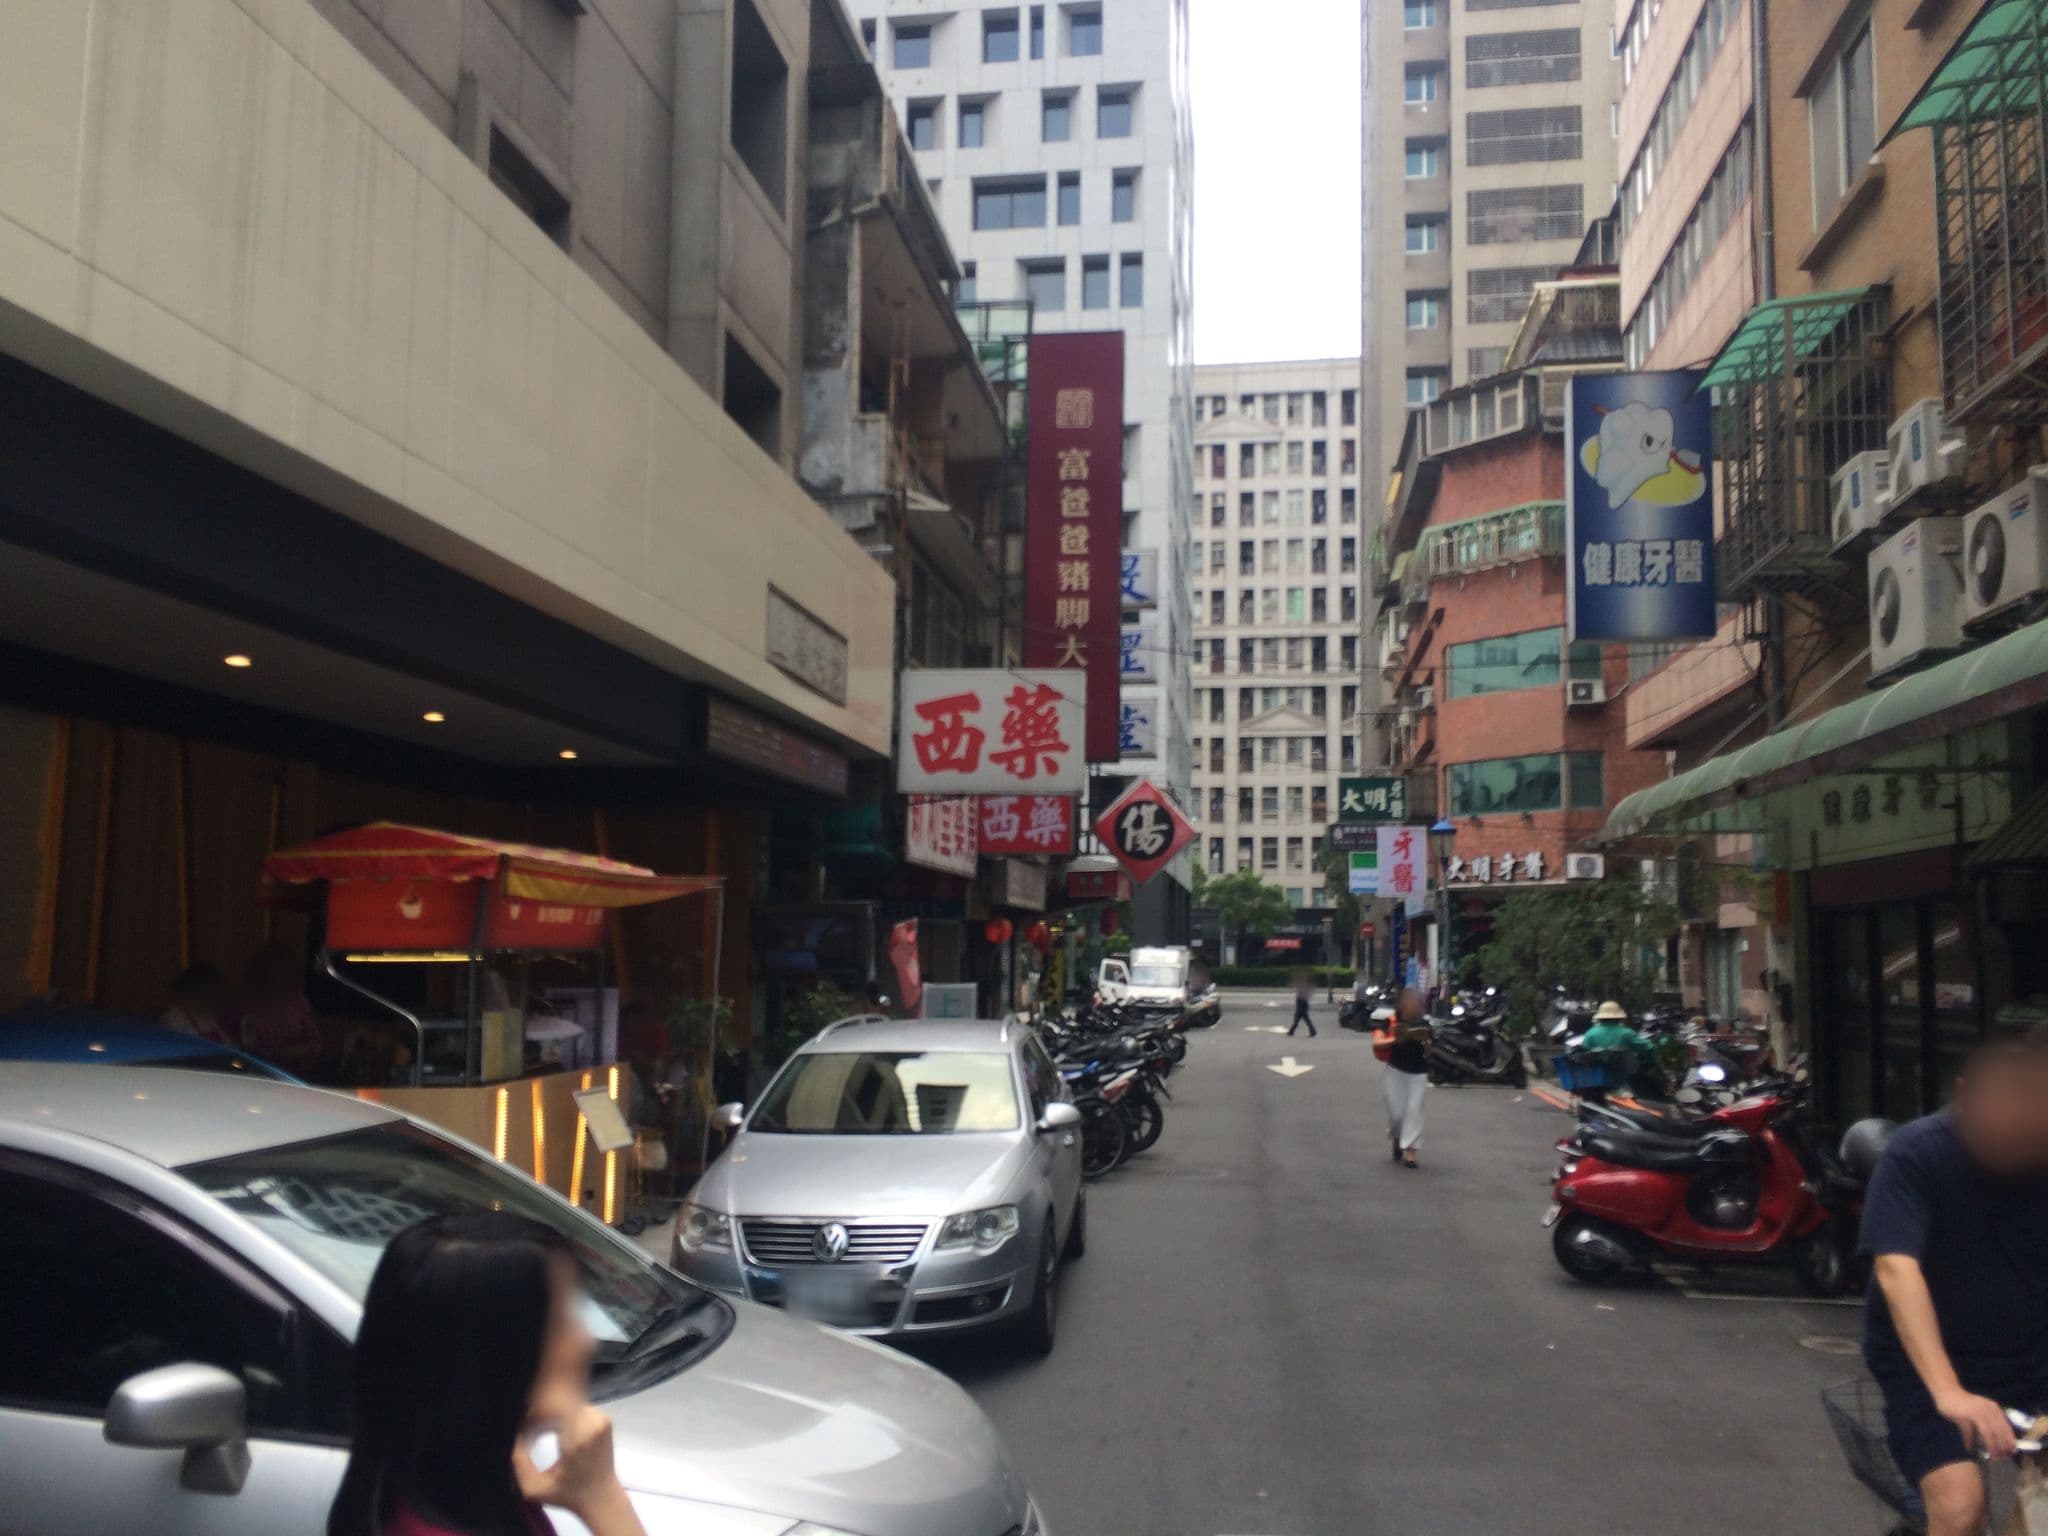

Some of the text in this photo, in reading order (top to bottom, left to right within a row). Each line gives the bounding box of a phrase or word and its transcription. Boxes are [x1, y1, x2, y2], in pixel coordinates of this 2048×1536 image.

[1583, 540, 1704, 586] 健康牙醫
[911, 683, 1070, 780] 西藥
[982, 796, 1067, 847] 西藥
[1388, 830, 1418, 894] 牙醫
